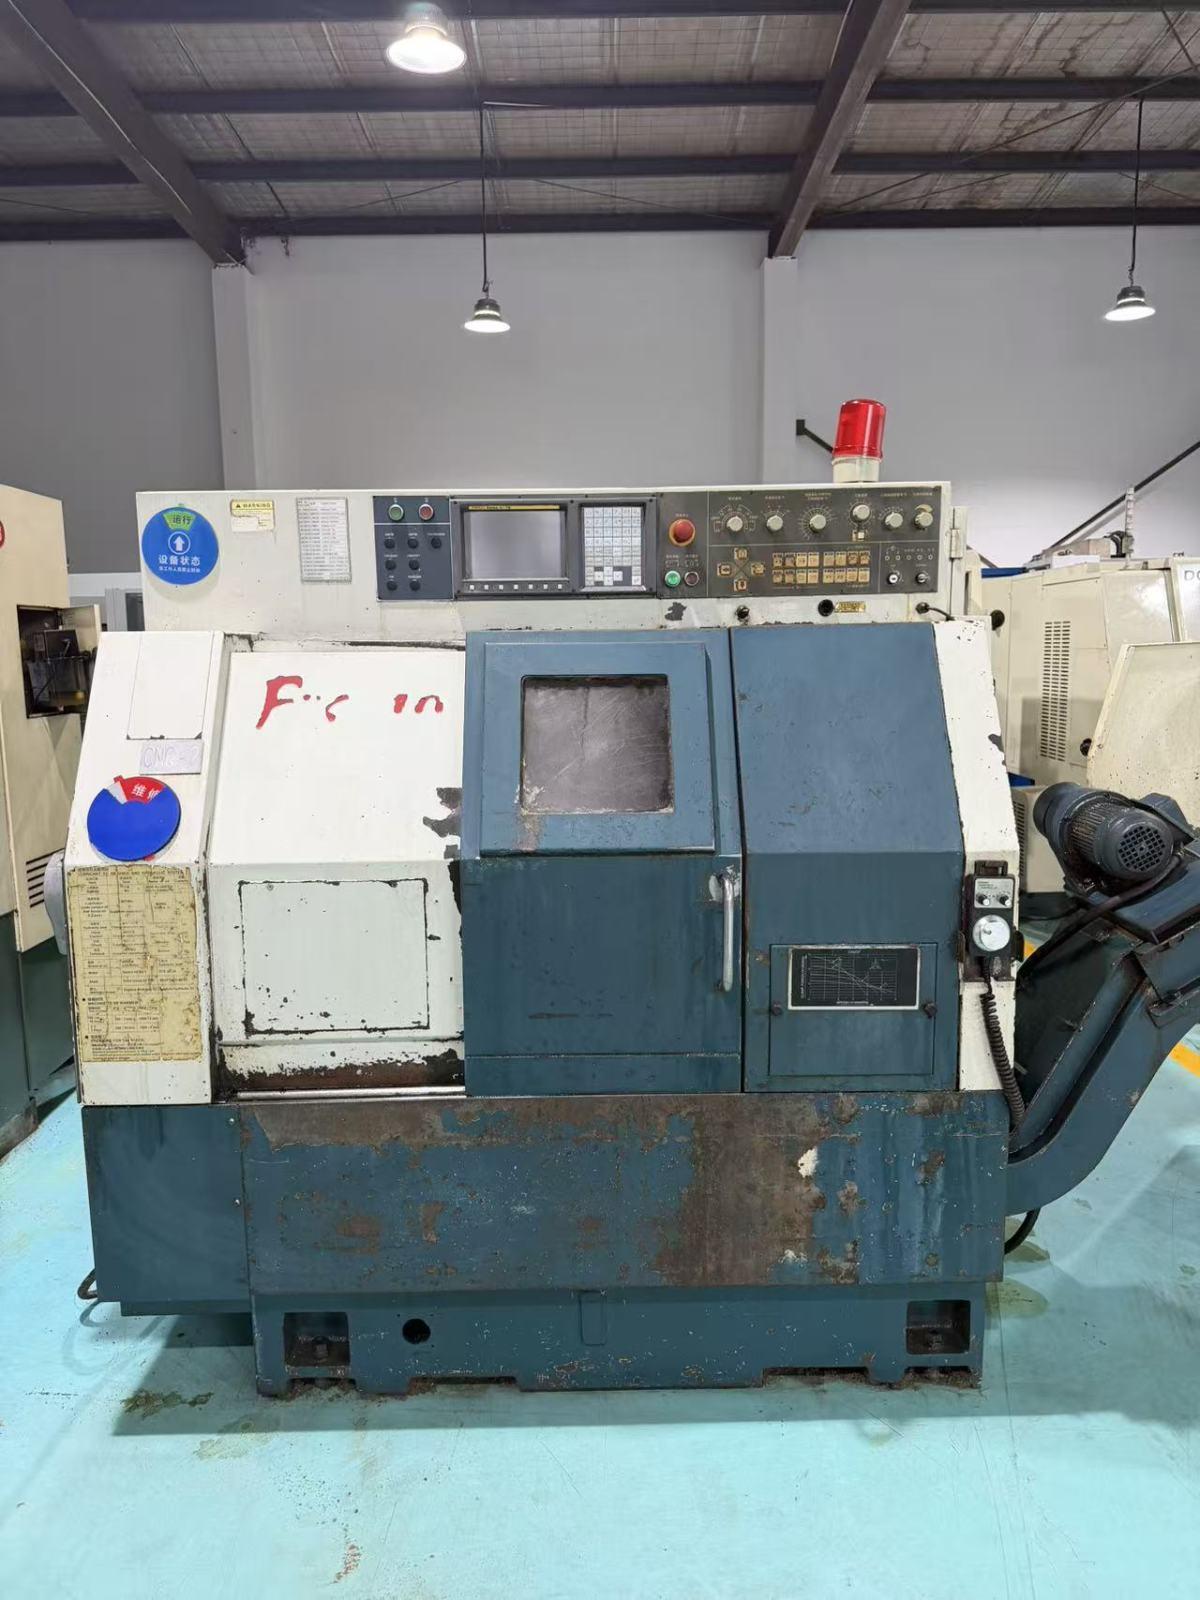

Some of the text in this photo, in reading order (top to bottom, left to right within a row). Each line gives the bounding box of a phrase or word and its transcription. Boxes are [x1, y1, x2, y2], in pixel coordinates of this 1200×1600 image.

[172, 514, 191, 525] 运行
[158, 554, 201, 567] 设备状态
